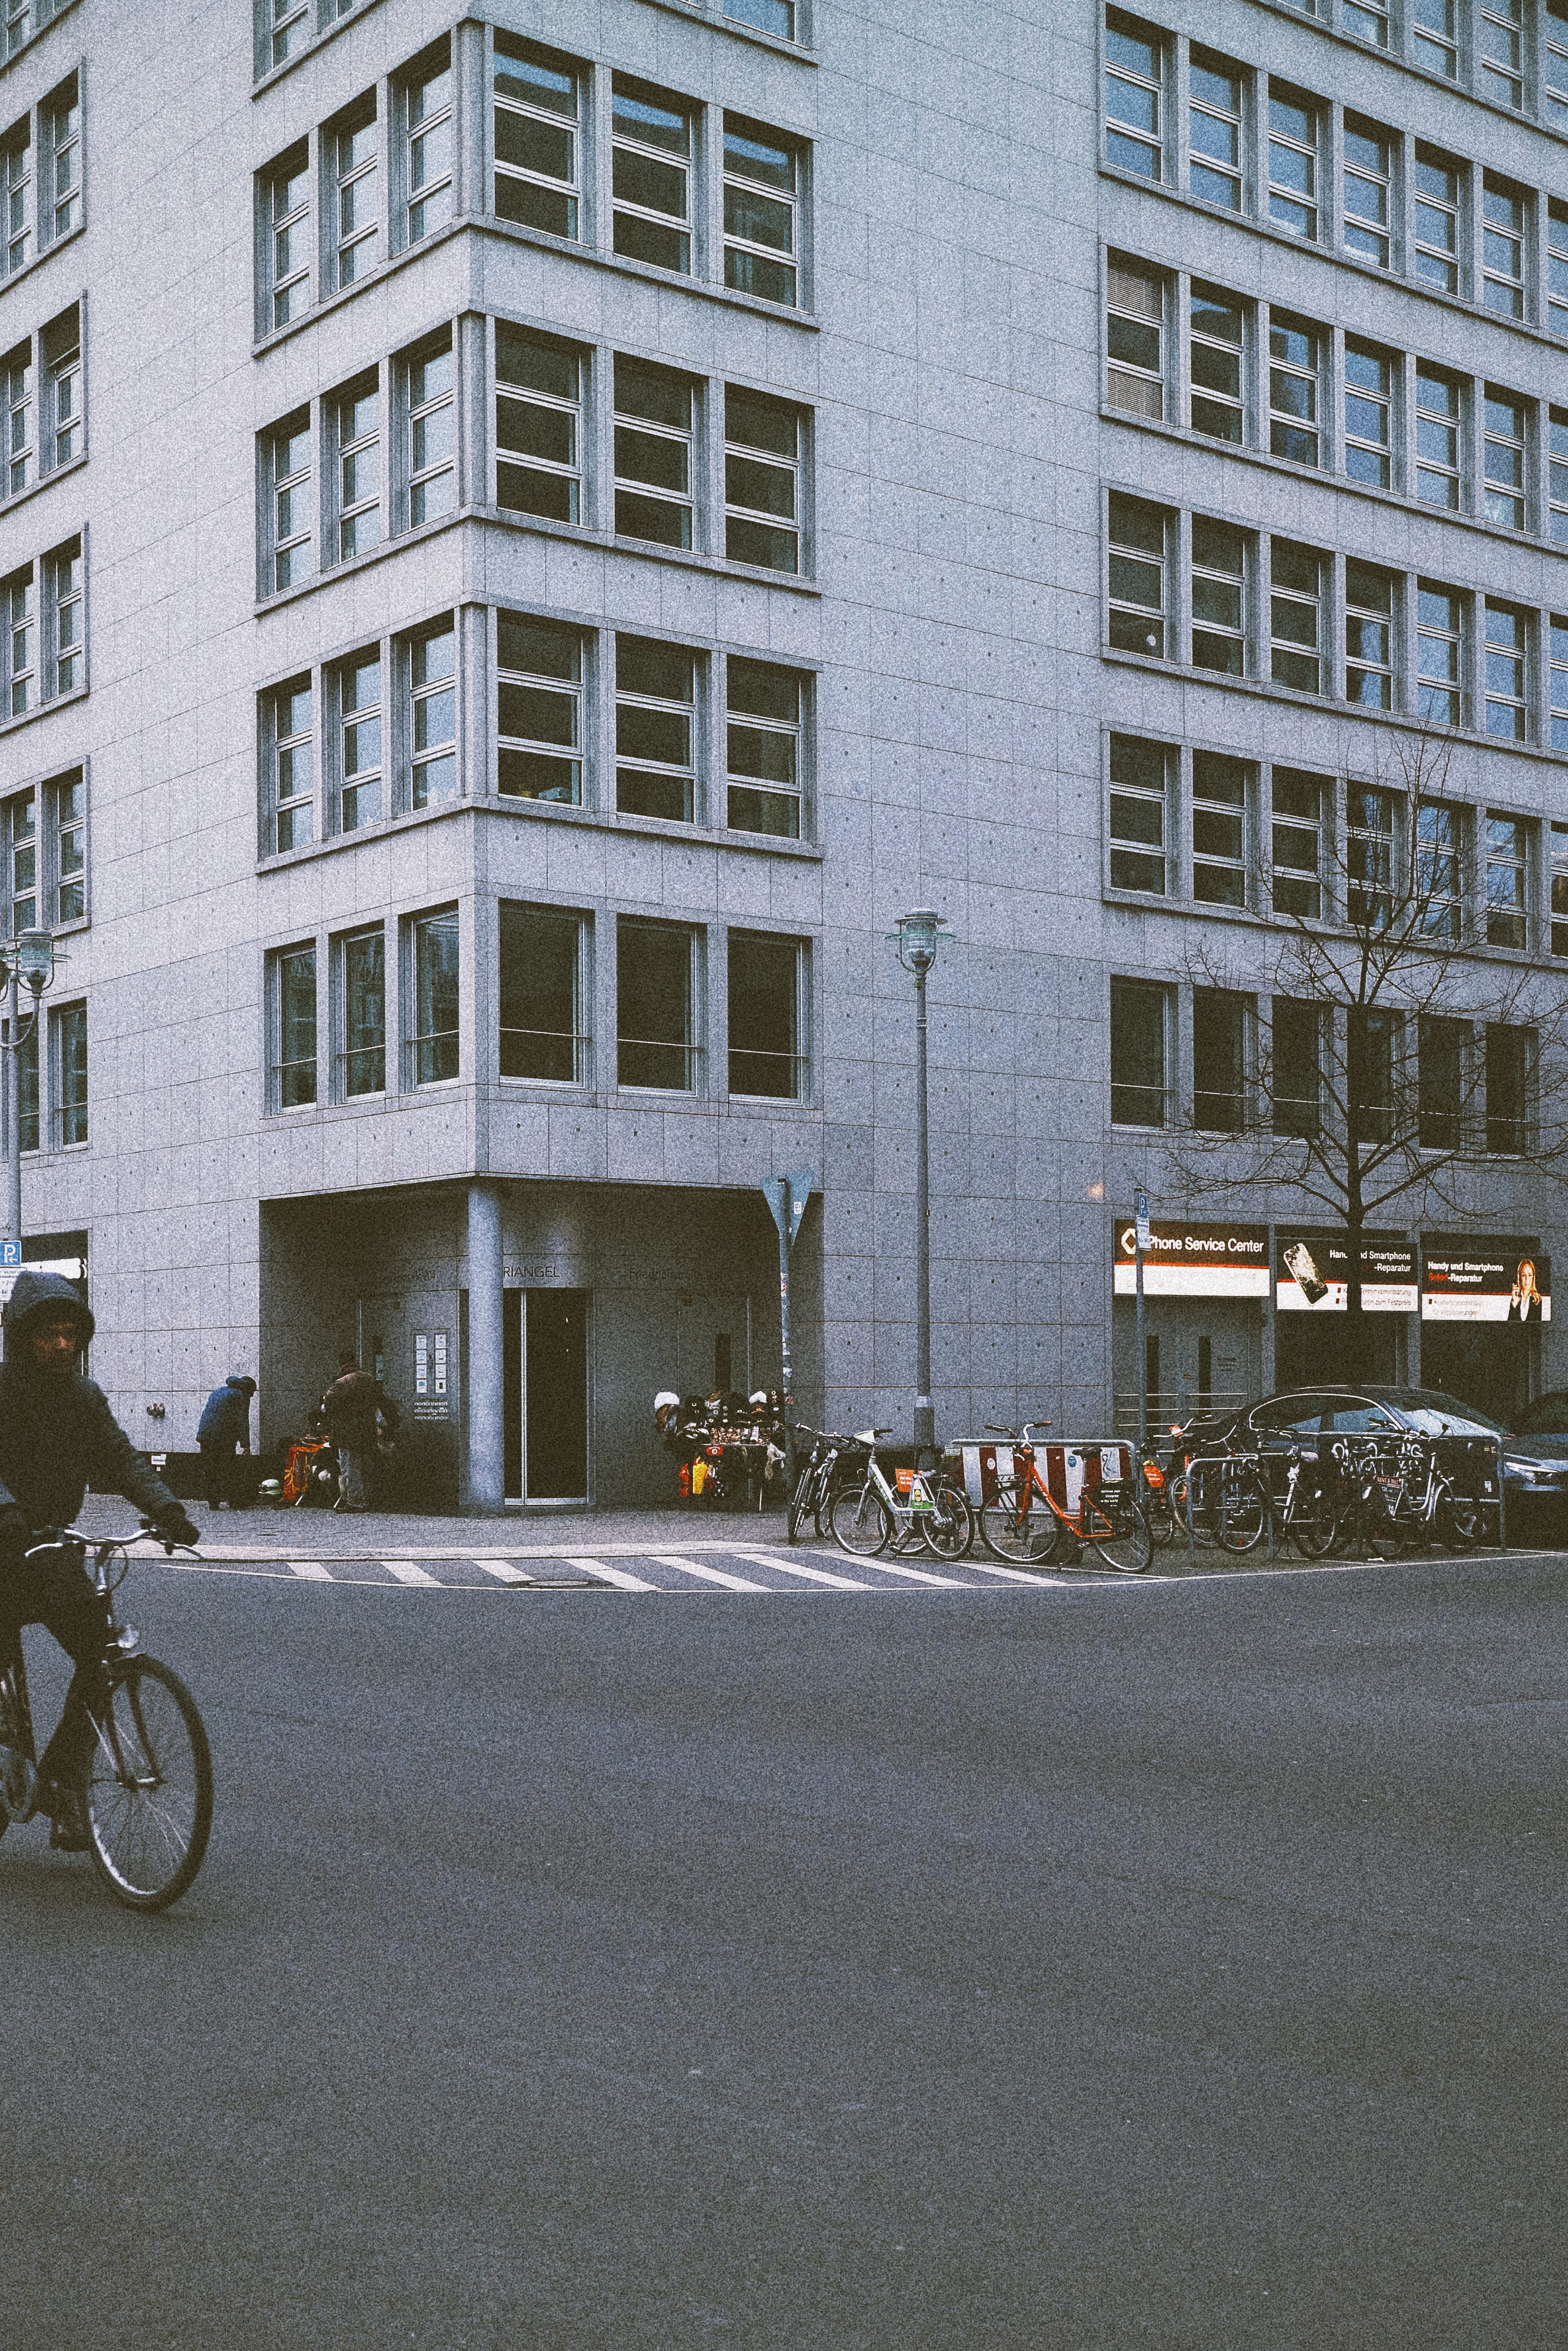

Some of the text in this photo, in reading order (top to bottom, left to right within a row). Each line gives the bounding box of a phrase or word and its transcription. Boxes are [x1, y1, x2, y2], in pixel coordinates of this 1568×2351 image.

[1185, 1236, 1226, 1251] Service
[1227, 1238, 1264, 1252] Center
[4, 1244, 16, 1263] P
[1329, 1249, 1348, 1259] Han
[1369, 1250, 1411, 1261] Smartphone
[503, 1266, 560, 1277] RIANGEL
[1428, 1261, 1504, 1273] Handy und Smartphone
